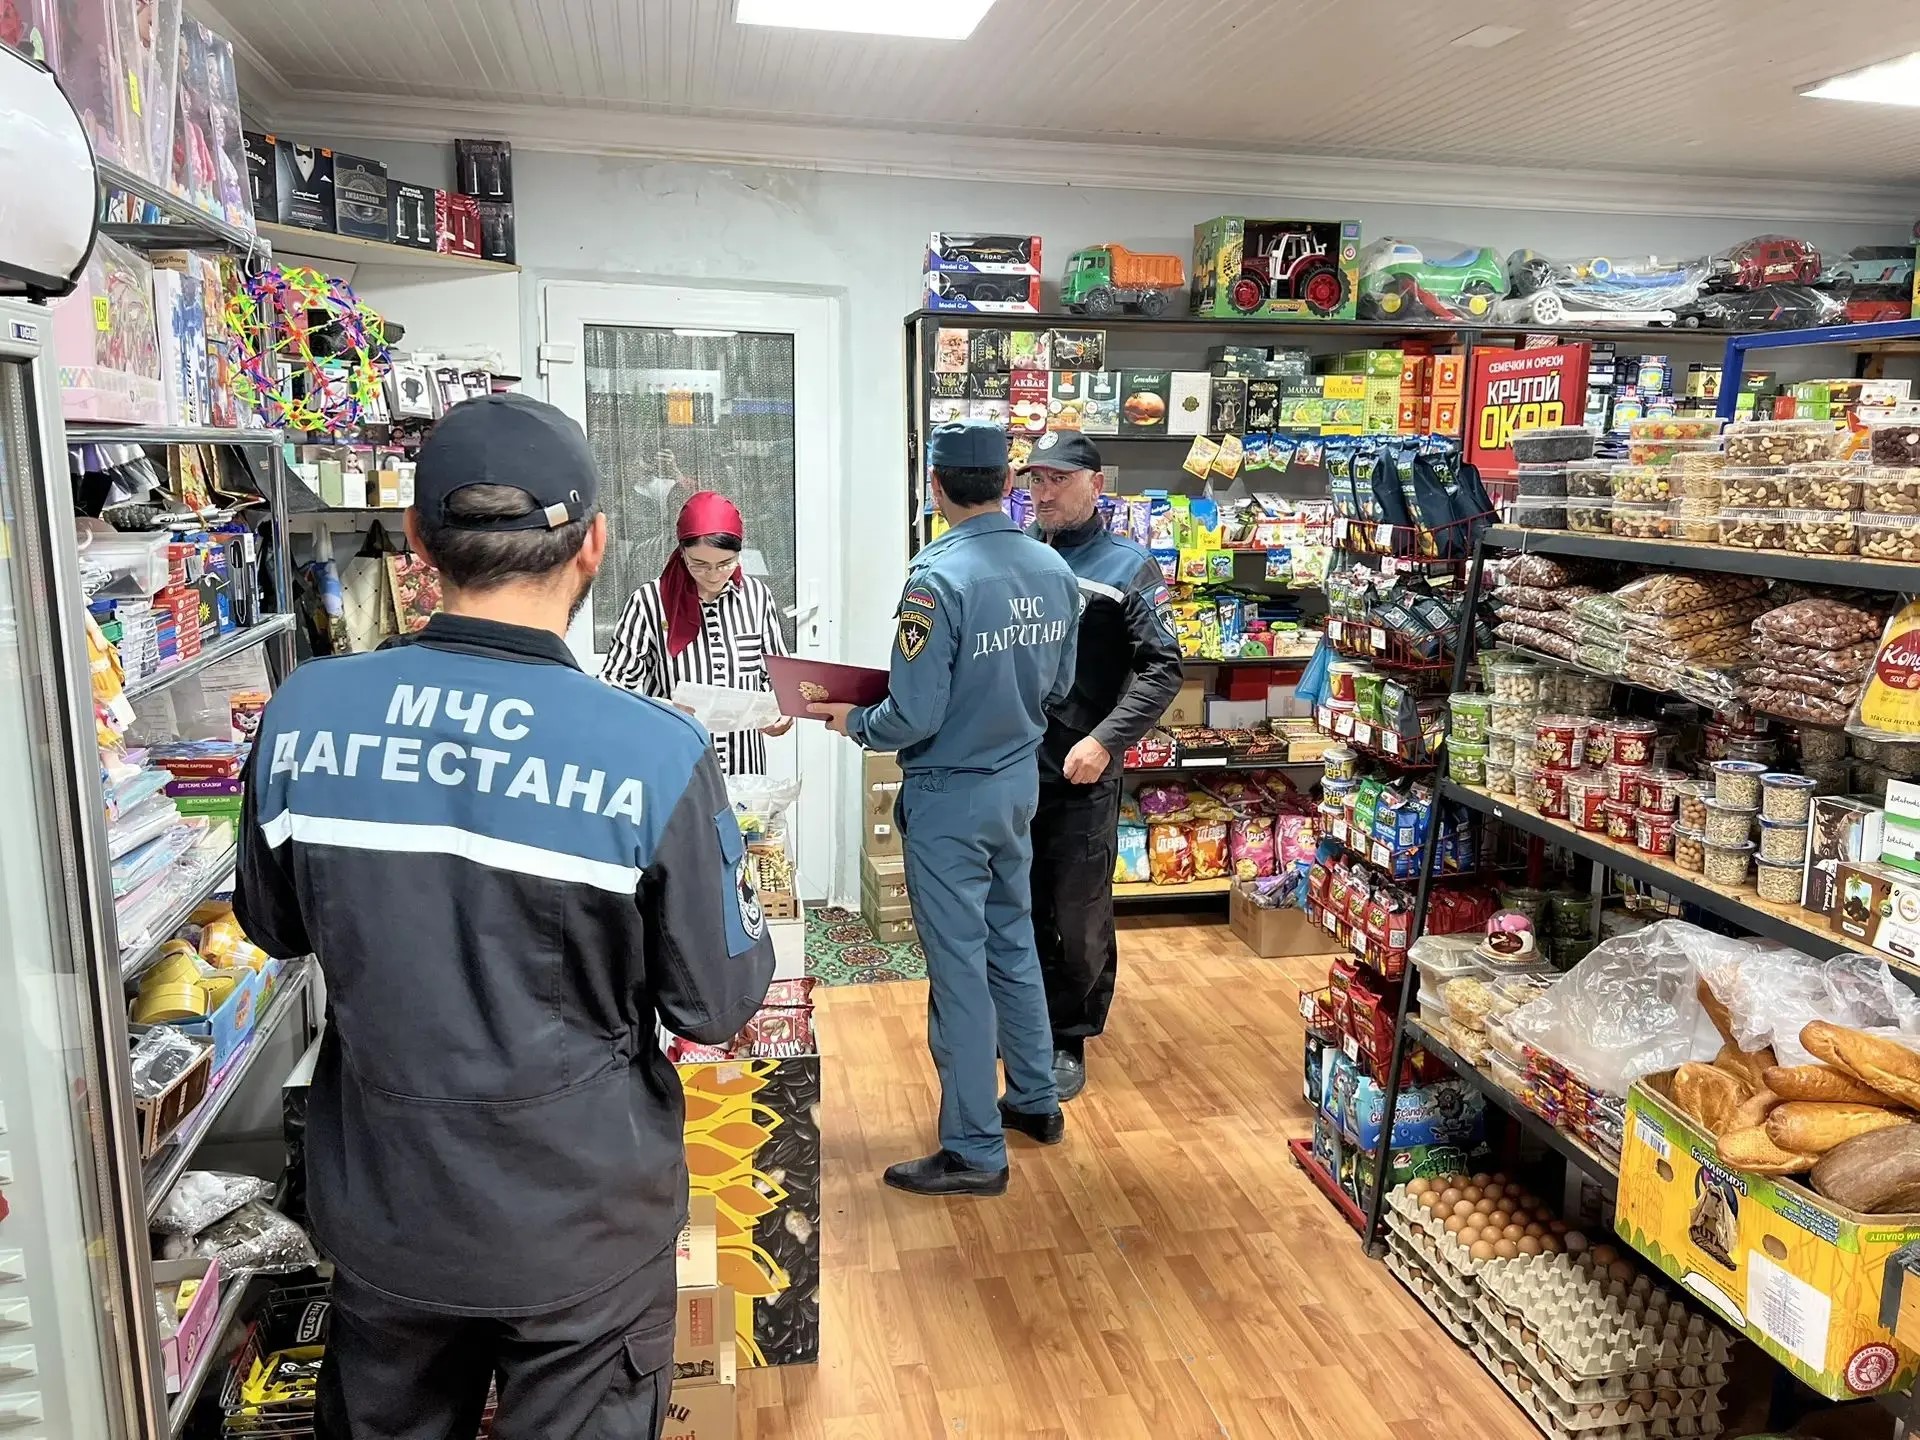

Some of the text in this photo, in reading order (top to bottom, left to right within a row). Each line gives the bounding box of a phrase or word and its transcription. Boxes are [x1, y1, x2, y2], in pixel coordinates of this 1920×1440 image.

[1488, 354, 1564, 374] СЕМЕЧКИ И ОРЕХИ
[186, 354, 194, 423] ELECTRIC
[935, 386, 965, 396] ABBAS
[976, 386, 1007, 396] ABBAS
[1014, 378, 1046, 388] AKBAR
[1287, 386, 1321, 395] MARYAM
[1487, 370, 1561, 406] КРУТОЙ
[385, 683, 536, 742] МЧС
[268, 729, 644, 827] ДАГЕСТАНА
[750, 1037, 805, 1059] АРАХИС
[302, 1303, 323, 1339] НЕФТЬ
